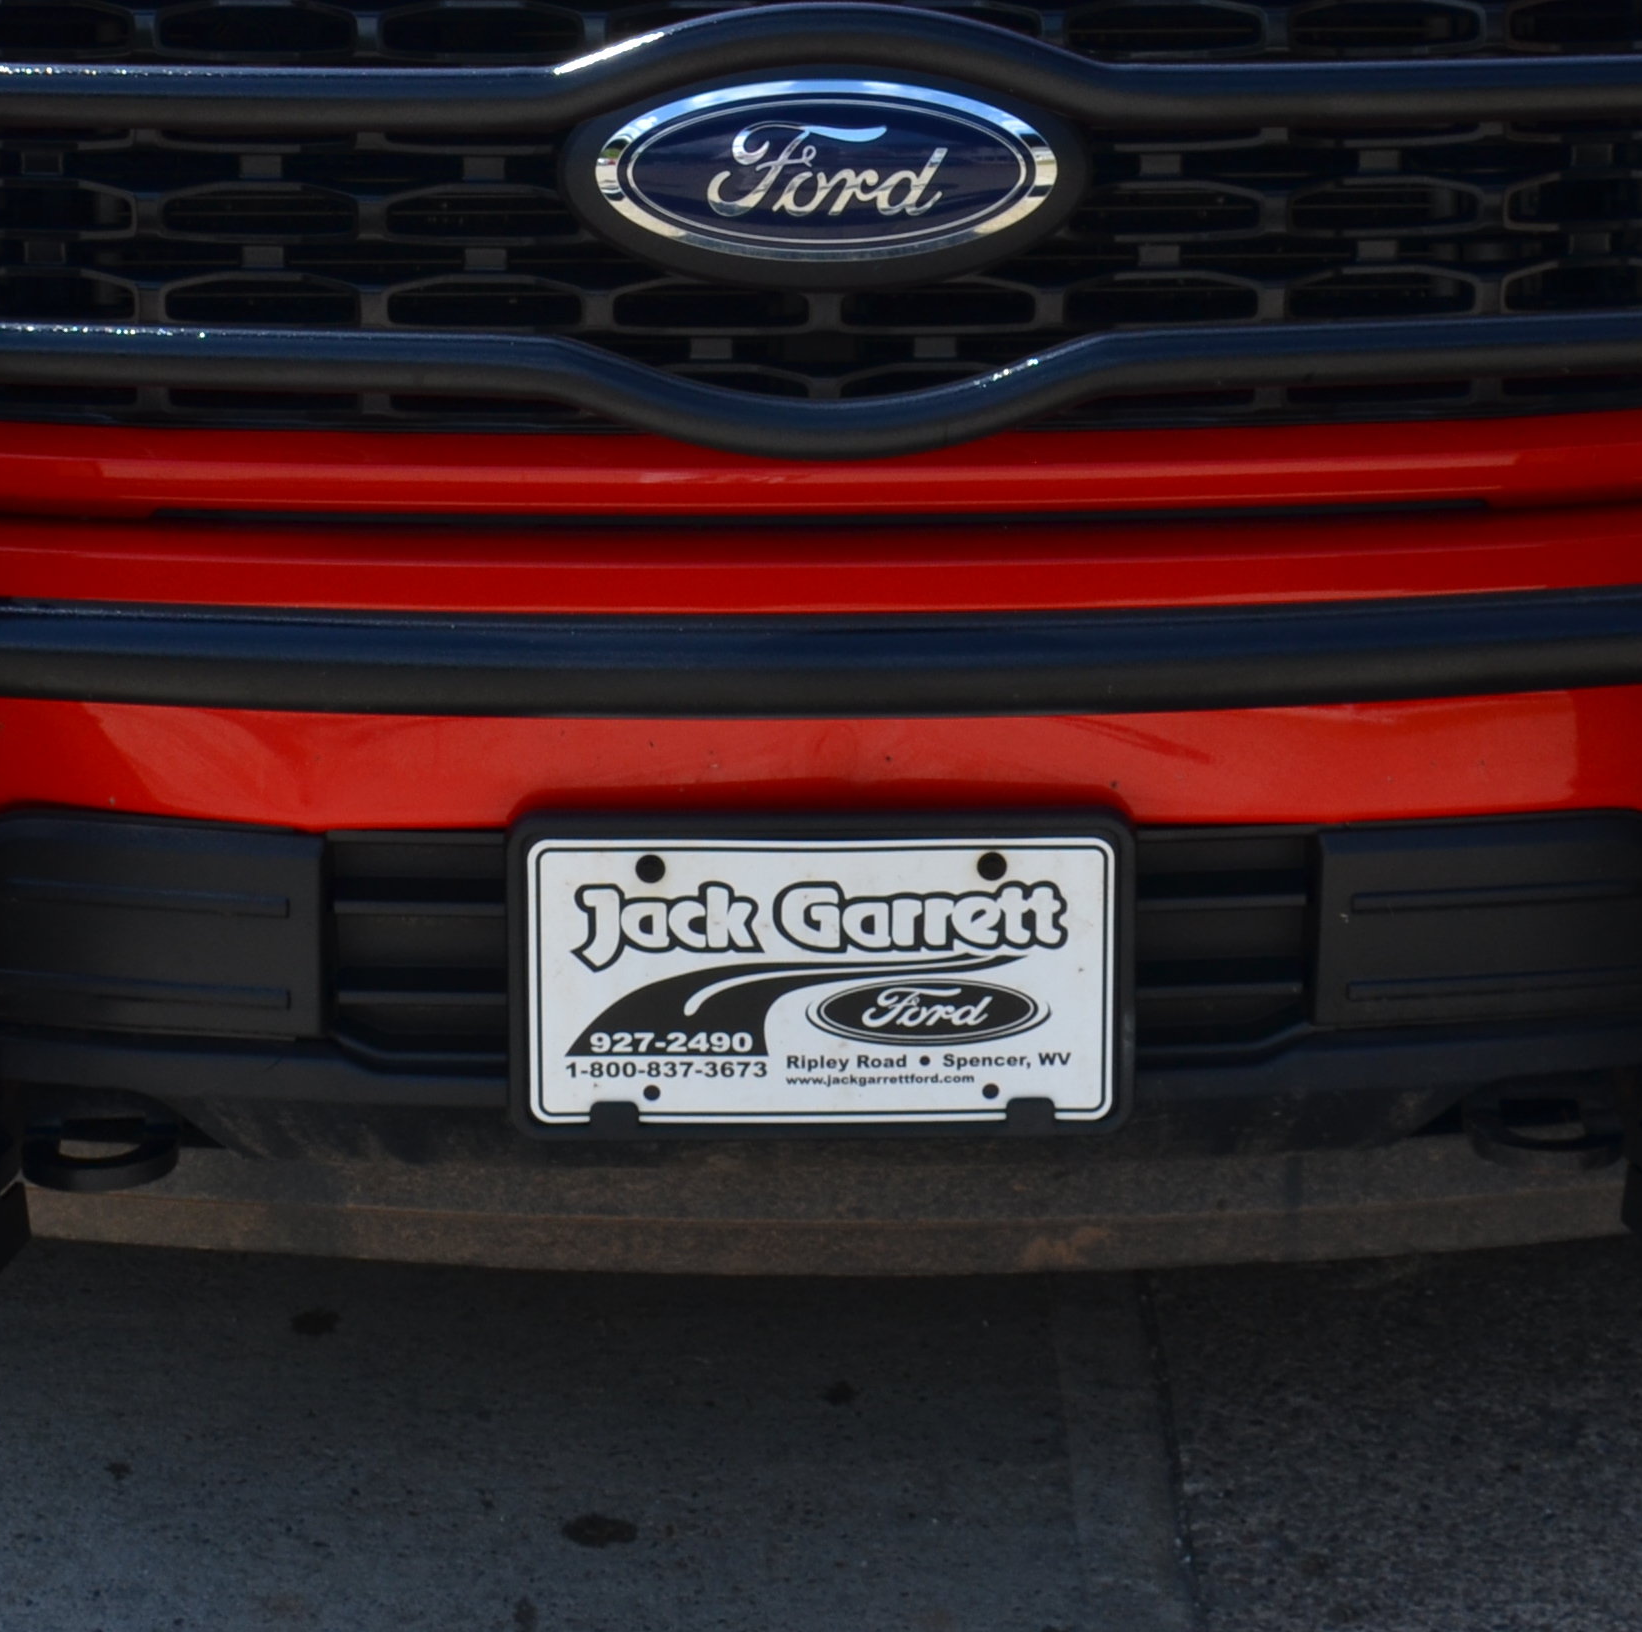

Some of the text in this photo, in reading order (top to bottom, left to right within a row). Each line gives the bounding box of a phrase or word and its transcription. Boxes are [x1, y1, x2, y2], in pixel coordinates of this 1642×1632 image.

[707, 120, 948, 217] Ford
[570, 879, 1068, 973] Jack Garrett
[861, 987, 993, 1028] Ford
[589, 1032, 754, 1053] 927-2490
[565, 1061, 768, 1078] 1-800-837-3673
[786, 1052, 1072, 1071] Ripley Road Spencer, WV
[785, 1073, 975, 1087] www.jackgarrettford.com
